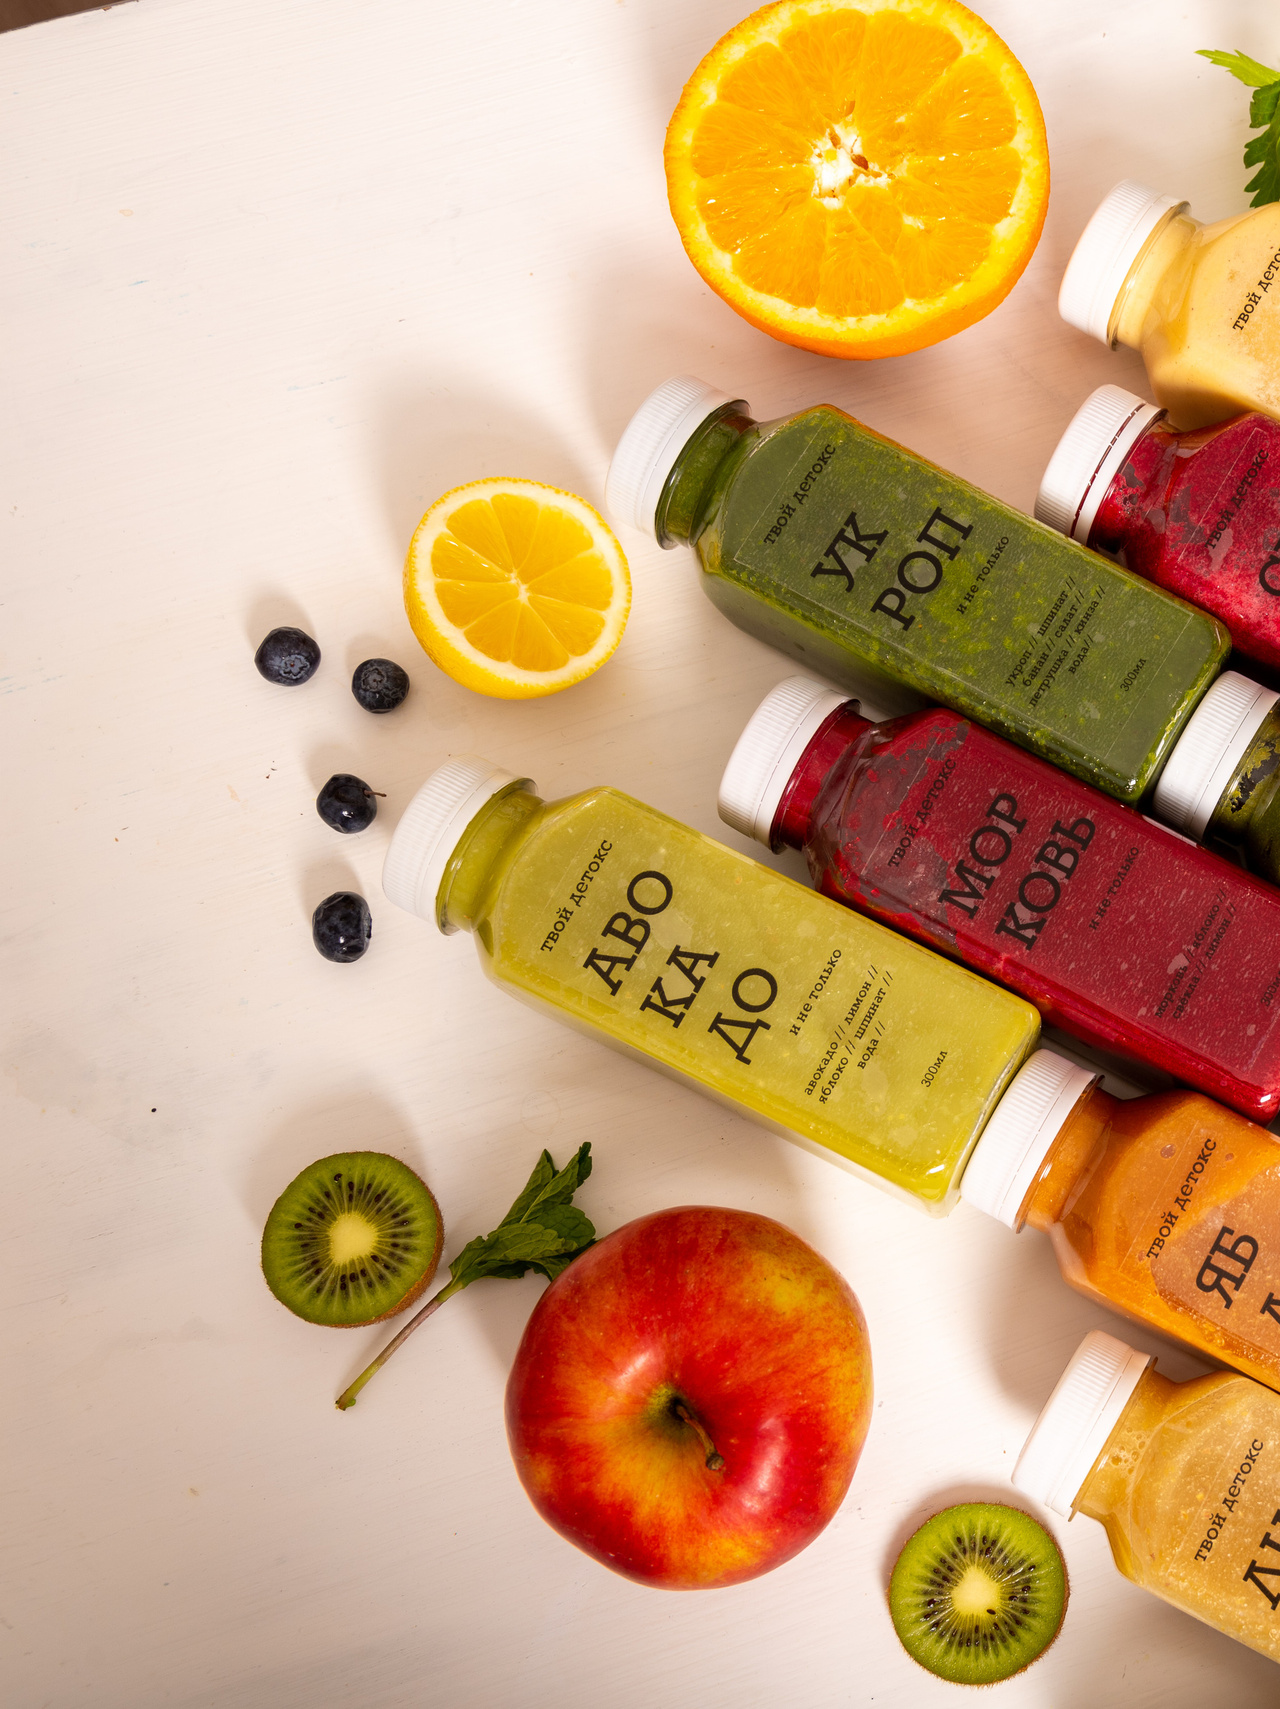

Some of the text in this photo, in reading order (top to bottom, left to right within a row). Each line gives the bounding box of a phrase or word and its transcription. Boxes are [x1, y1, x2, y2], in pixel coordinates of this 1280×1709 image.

[1231, 291, 1263, 331] твой
[762, 443, 837, 545] твой детокс
[1203, 448, 1270, 550] твой детокс
[809, 510, 890, 594] УК
[869, 505, 975, 633] РОП
[955, 535, 1010, 616] и не только
[1004, 589, 1069, 688] укроп шпинат
[1021, 603, 1079, 688] банан салат
[1028, 600, 1100, 709] петрушка кинза
[1119, 657, 1148, 693] 300мл
[886, 758, 957, 868] твой детокс
[937, 791, 1029, 920] МОР
[539, 839, 614, 953] твой детокс
[582, 869, 674, 997] АВО
[994, 816, 1097, 951] КОВЬ
[1088, 918, 1101, 931] и
[1094, 897, 1112, 919] не
[638, 944, 721, 1029] КА
[706, 967, 779, 1066] ДО
[788, 948, 843, 1037] и не только
[803, 980, 873, 1097] авокадо лимон
[818, 987, 887, 1105] яблоко шпинат
[856, 1038, 880, 1070] вода
[920, 1050, 949, 1089] 300мл
[1145, 1137, 1218, 1260] твой детокс
[1195, 1225, 1260, 1311] ЯБ
[1193, 1438, 1264, 1562] твой детокс
